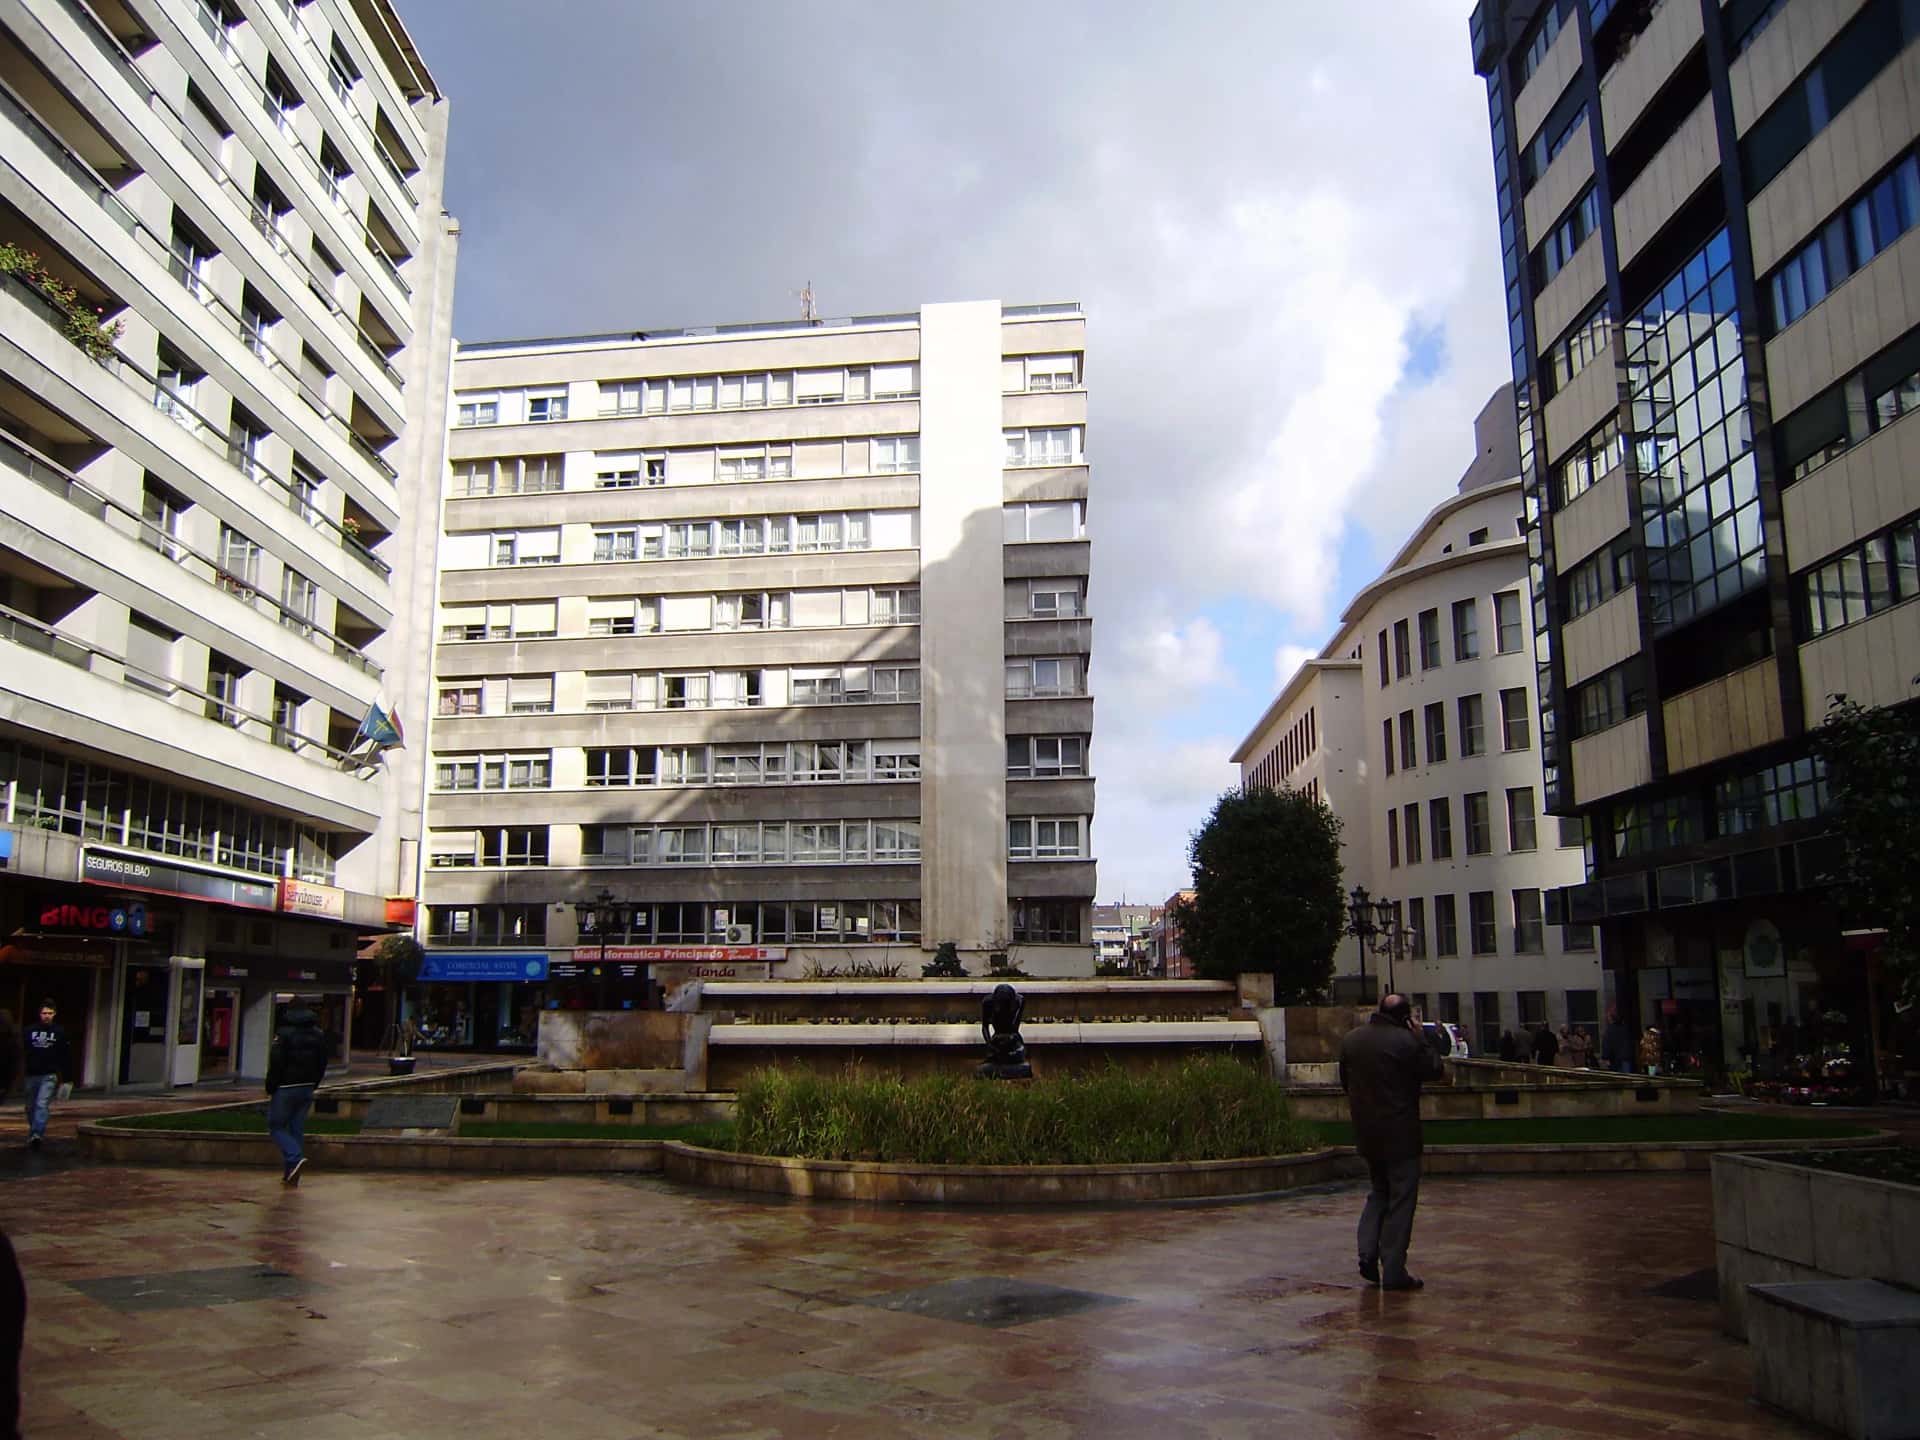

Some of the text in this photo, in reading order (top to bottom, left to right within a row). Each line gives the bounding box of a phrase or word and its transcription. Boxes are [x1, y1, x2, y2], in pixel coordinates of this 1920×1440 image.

[87, 856, 151, 878] SEGUROS BILBAO
[663, 949, 724, 962] Principado
